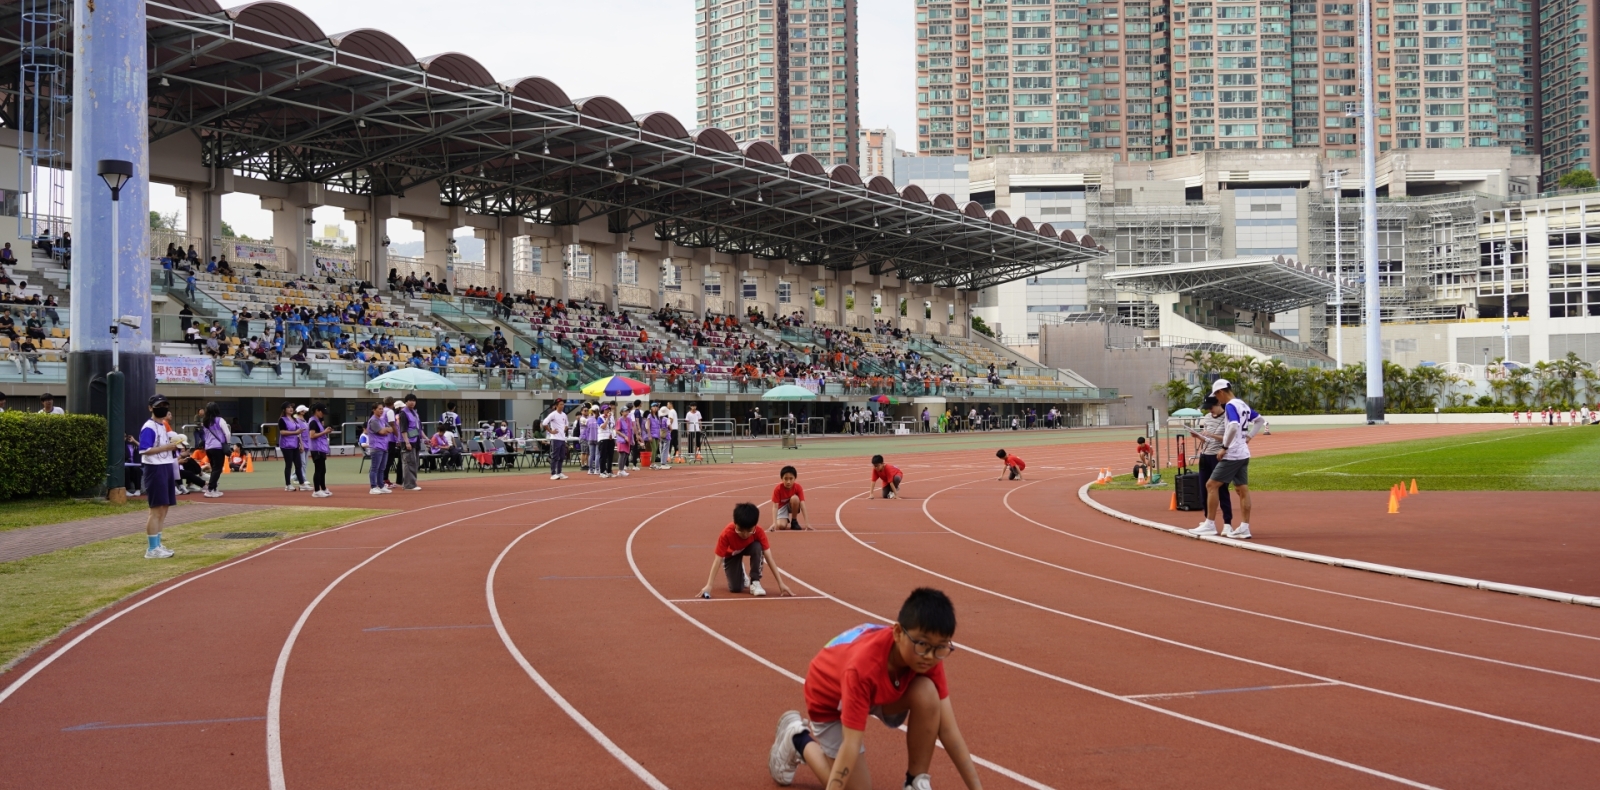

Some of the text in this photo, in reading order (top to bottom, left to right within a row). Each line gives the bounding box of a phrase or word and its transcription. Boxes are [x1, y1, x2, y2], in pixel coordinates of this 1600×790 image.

[155, 365, 199, 377] 學校運動會
[340, 447, 345, 455] 2
